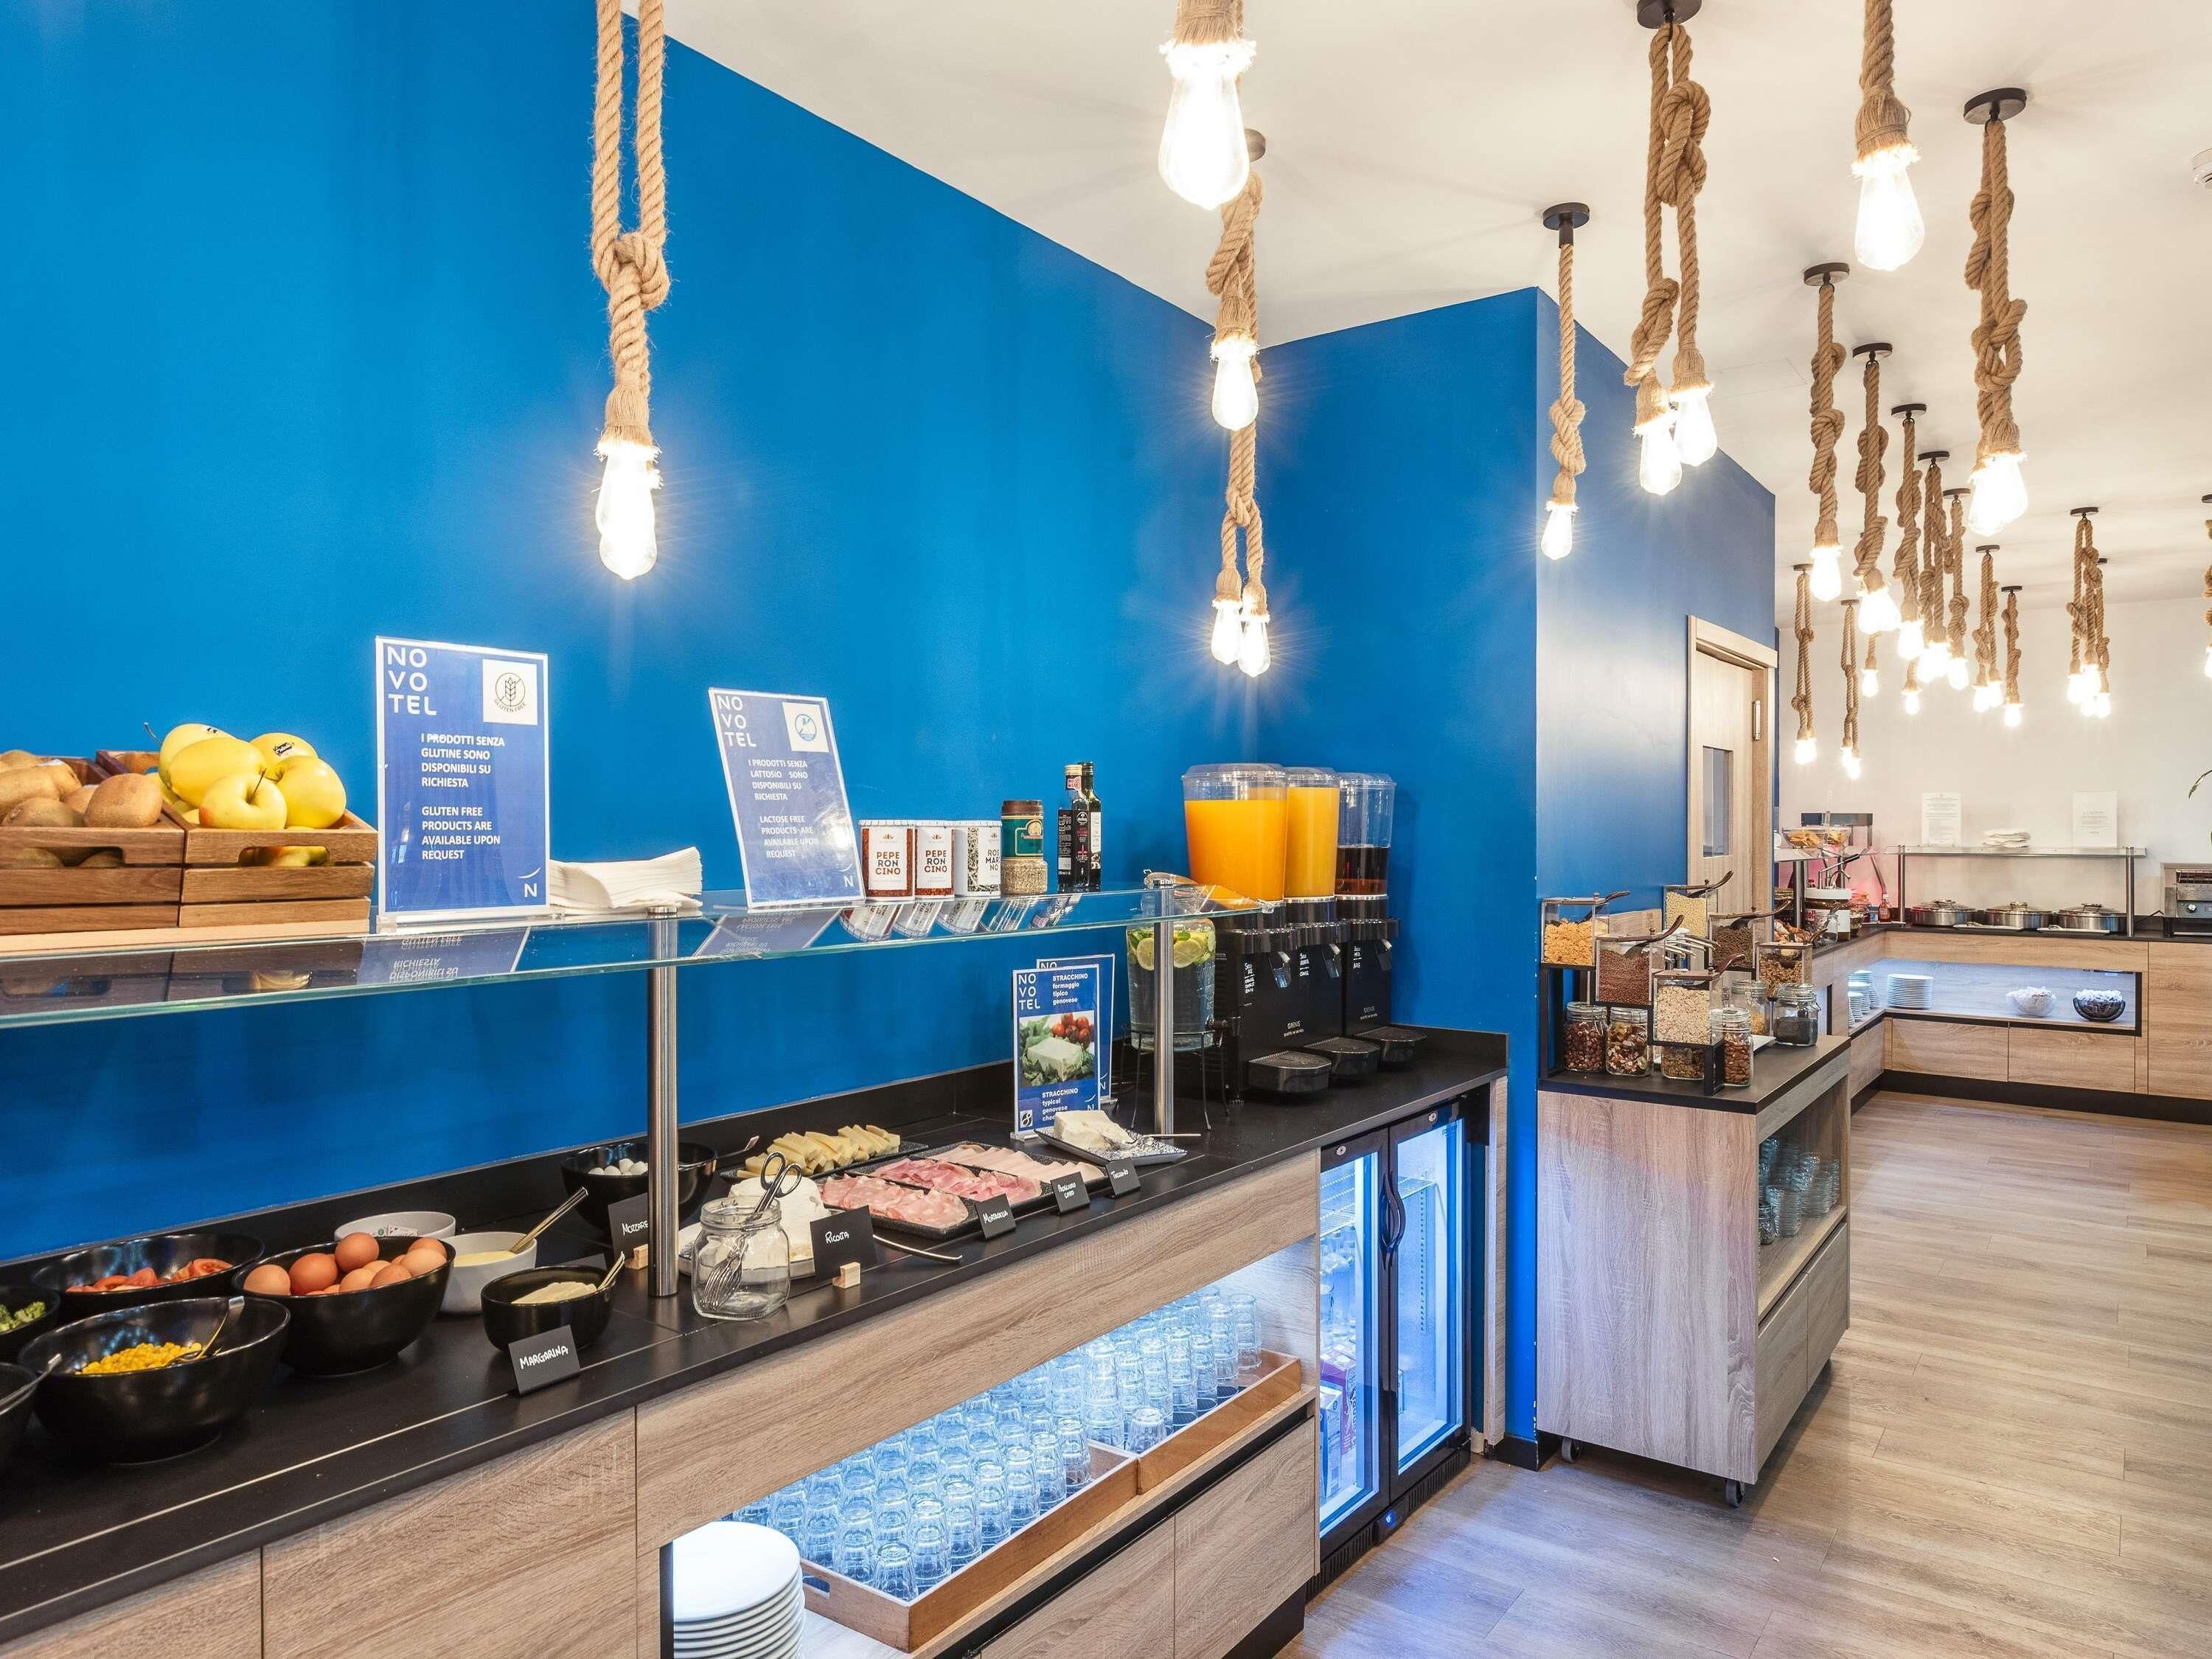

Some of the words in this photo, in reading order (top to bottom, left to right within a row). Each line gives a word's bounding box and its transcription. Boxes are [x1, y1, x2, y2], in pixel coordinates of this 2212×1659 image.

[387, 646, 428, 668] NO
[388, 669, 428, 692] VO
[389, 694, 437, 716] TEL
[717, 695, 743, 711] NO
[720, 713, 747, 729] VO
[421, 733, 425, 743] I
[427, 734, 474, 745] PRODOTTI
[476, 736, 506, 747] SENZA
[724, 731, 757, 748] TEL
[421, 748, 462, 759] GLUTINE
[463, 750, 491, 760] SONO
[421, 762, 477, 773] DISPONIBILI
[479, 765, 491, 774] SU
[748, 759, 752, 767] I
[752, 759, 786, 767] PRODOTTI
[751, 770, 782, 778] LATTOSIO
[422, 777, 469, 787] RICHIESTA
[752, 782, 792, 790] DISPONIBILI
[754, 793, 788, 801] RICHIESTA
[422, 806, 459, 816] GLUTEN
[461, 807, 484, 816] FREE
[759, 815, 788, 824] LACTOSE
[422, 821, 473, 830] PRODUCTS
[474, 821, 493, 830] ARE
[761, 827, 797, 835] PRODUCTS
[422, 835, 472, 846] AVAILABLE
[473, 835, 501, 845] UPON
[764, 838, 799, 846] AVAILABLE
[422, 850, 465, 860] REQUEST
[766, 849, 797, 858] REQUEST
[844, 875, 854, 887] N
[524, 883, 538, 897] N
[1018, 973, 1036, 984] NO
[1052, 973, 1088, 981] STRACCHINO
[1019, 987, 1036, 997] VO
[1019, 999, 1040, 1010] TEL
[1042, 1088, 1079, 1098] STRACCHINO
[1042, 1098, 1061, 1107] typical
[519, 1345, 568, 1369] MARGARINA
